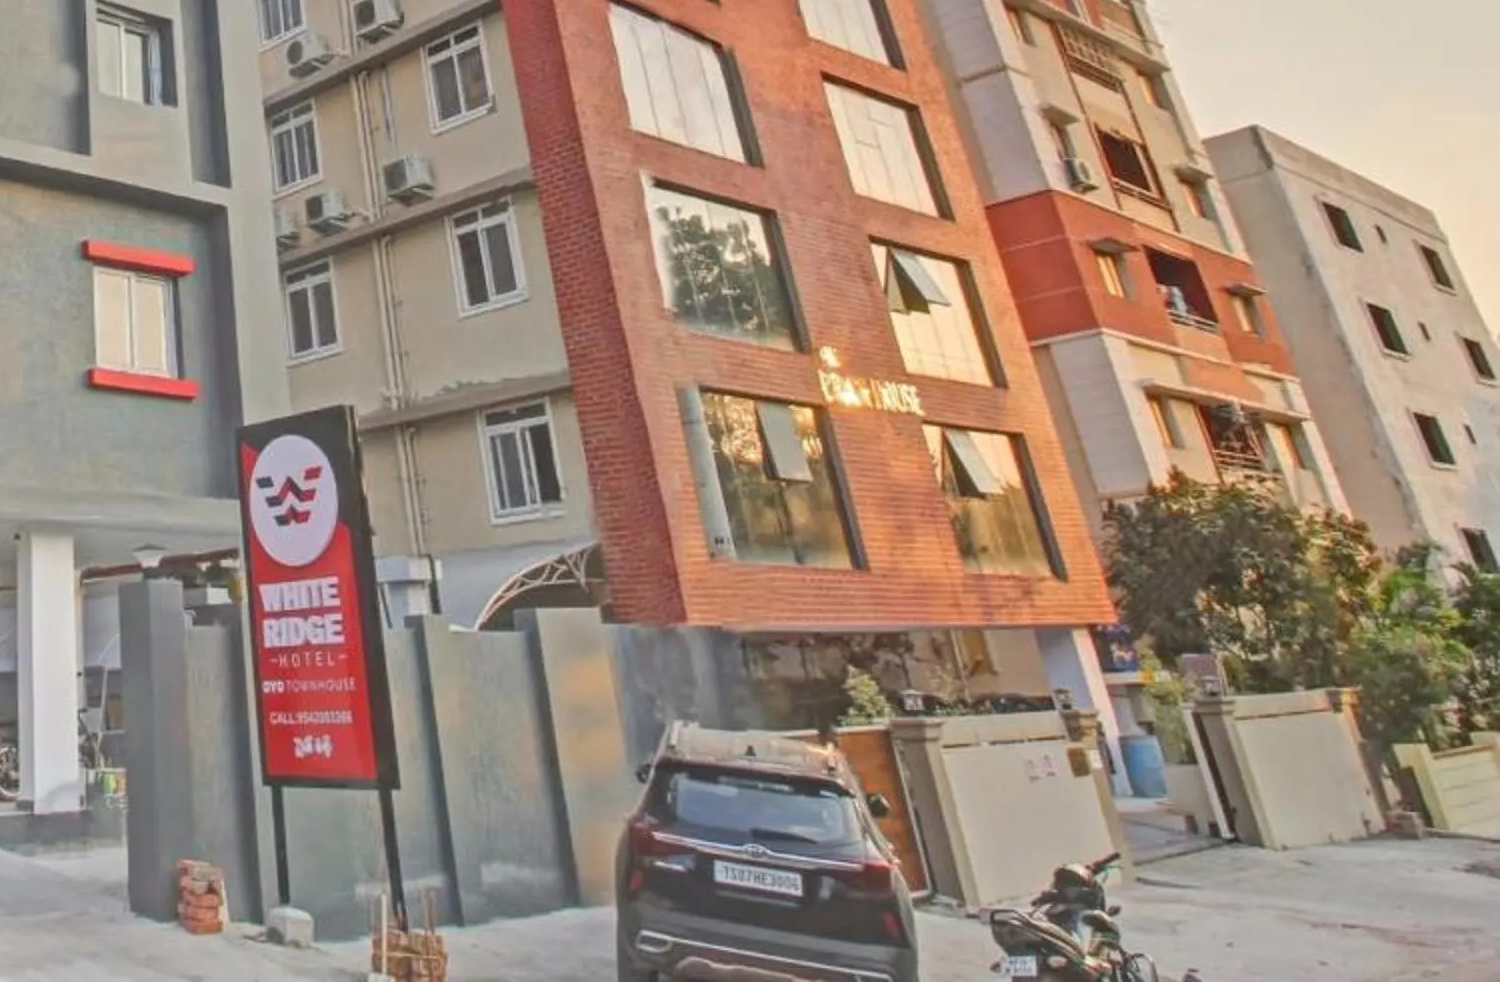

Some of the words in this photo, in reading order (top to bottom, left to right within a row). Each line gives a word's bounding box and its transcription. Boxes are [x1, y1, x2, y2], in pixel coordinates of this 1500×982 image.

[259, 576, 341, 612] WHITE
[262, 613, 345, 649] RIDGE
[262, 680, 284, 694] OYO
[285, 677, 356, 693] TOWNHOUSE
